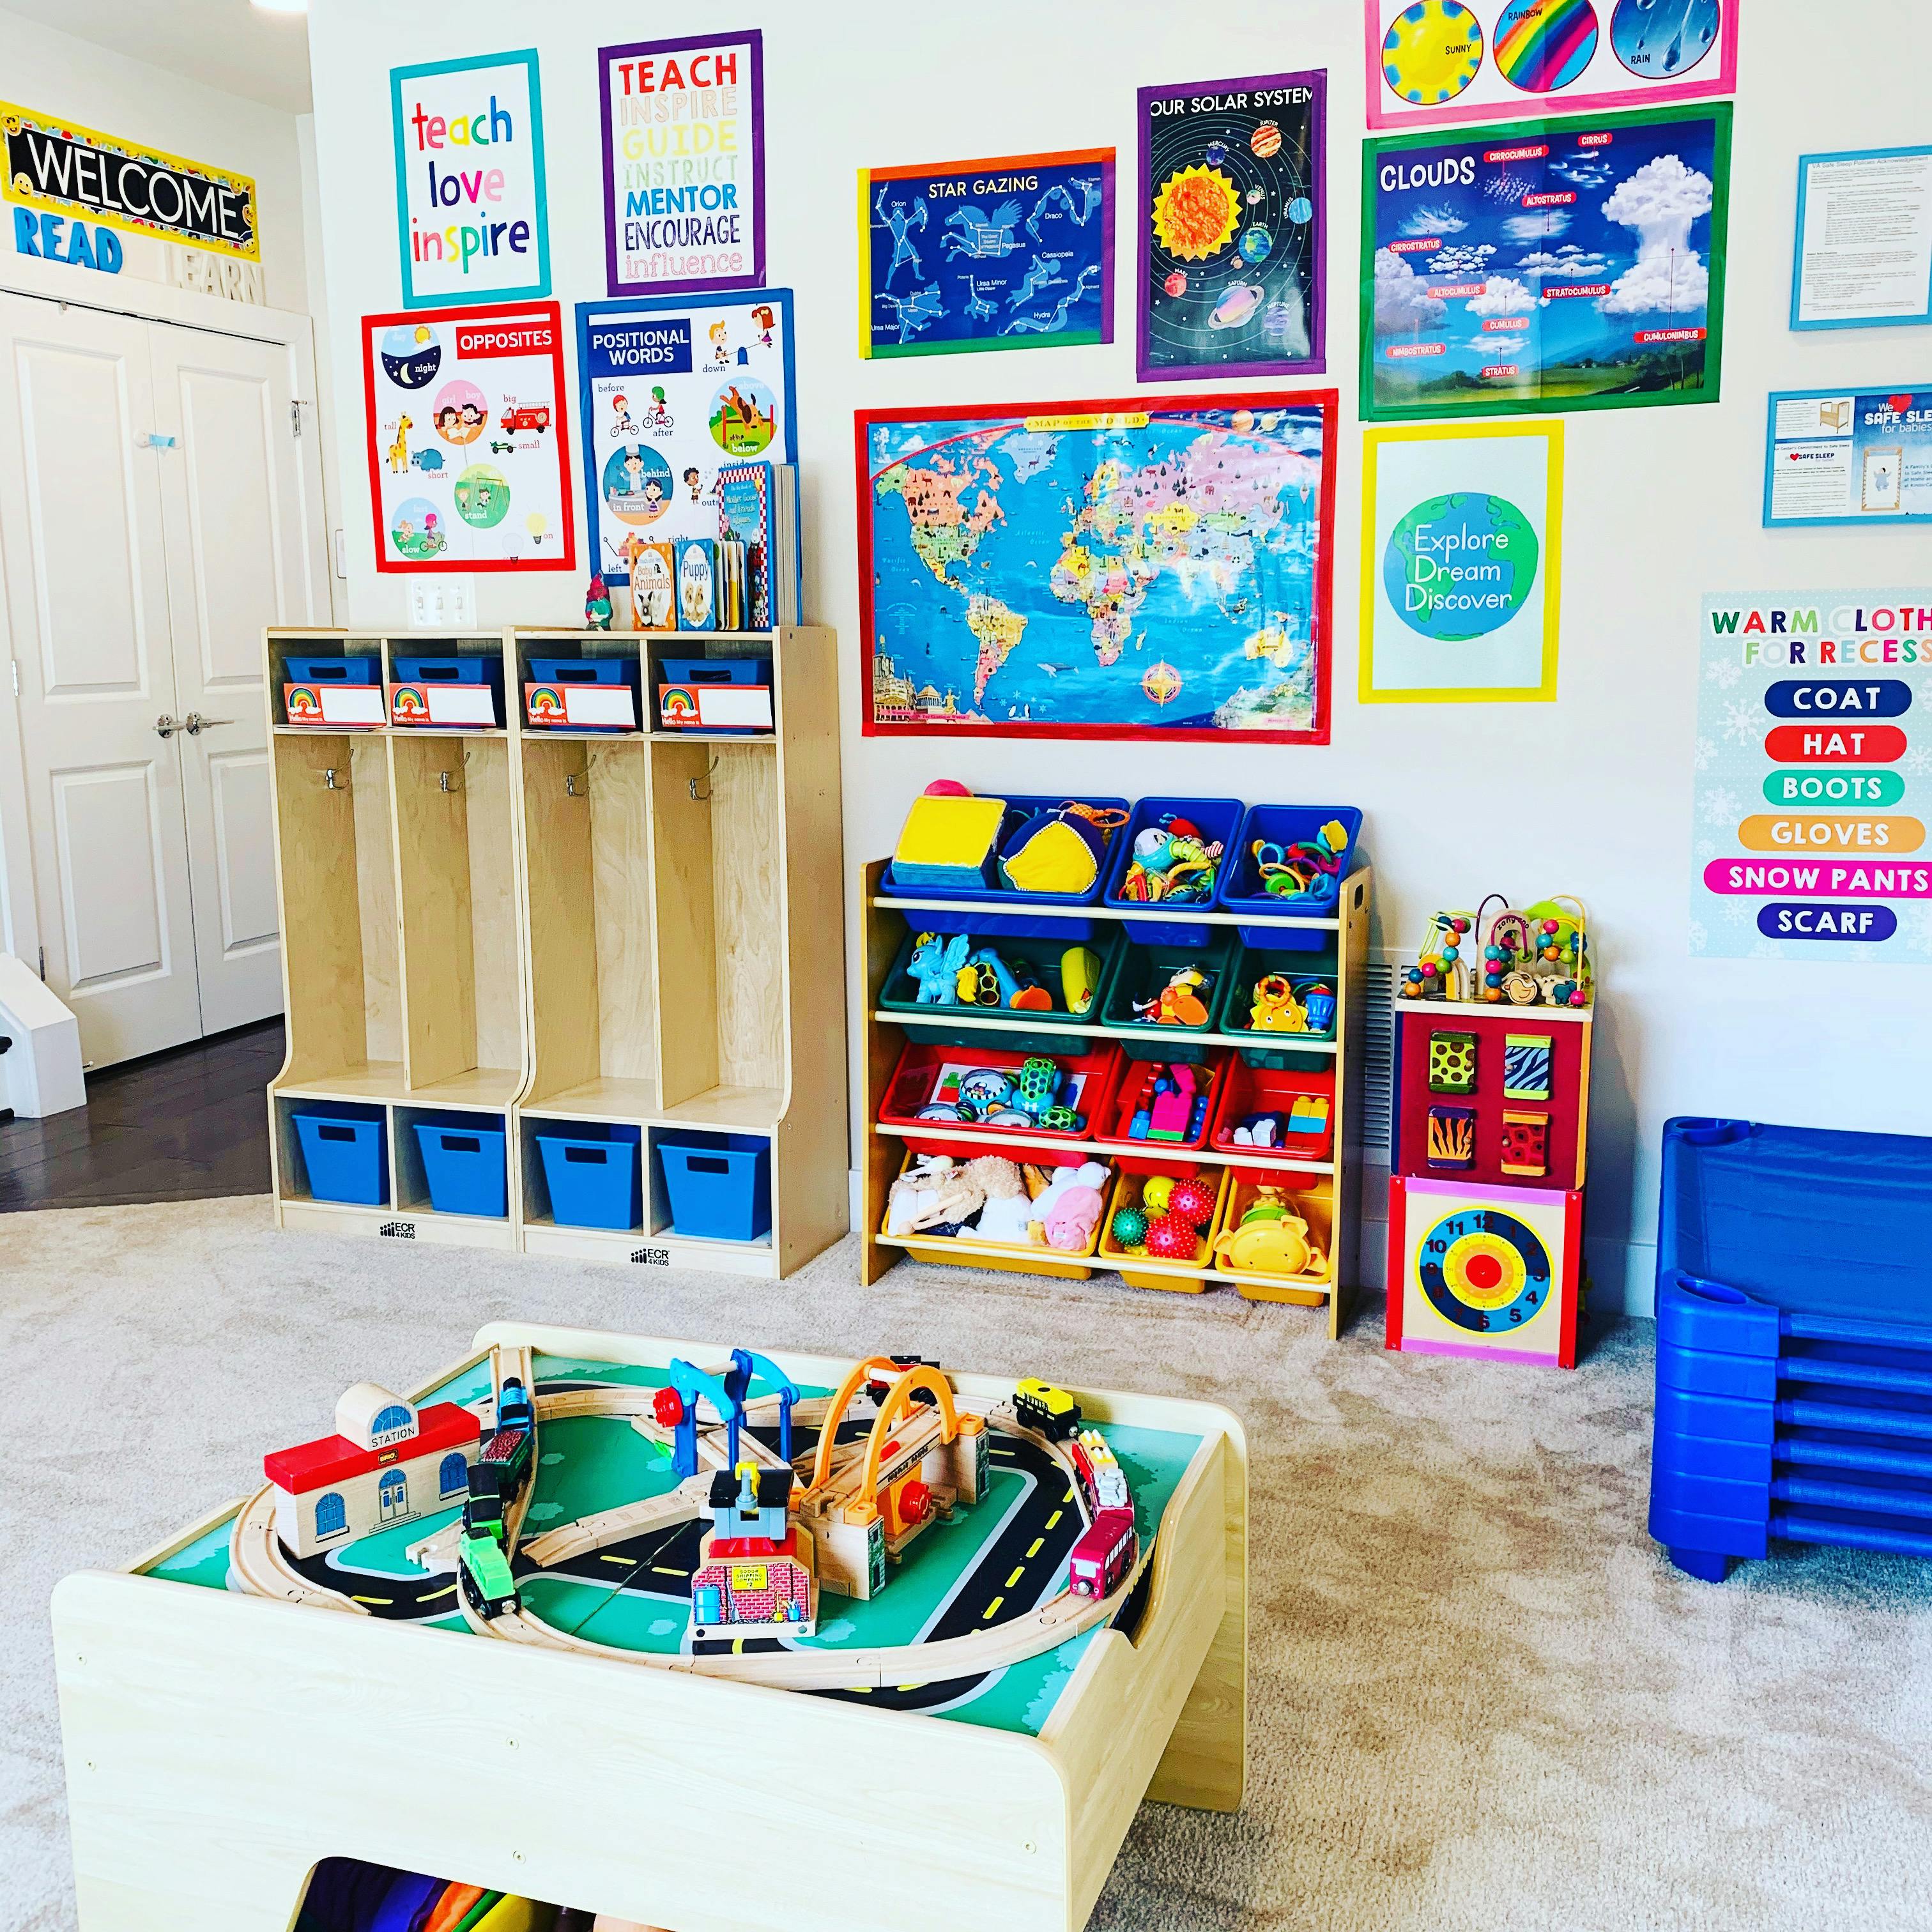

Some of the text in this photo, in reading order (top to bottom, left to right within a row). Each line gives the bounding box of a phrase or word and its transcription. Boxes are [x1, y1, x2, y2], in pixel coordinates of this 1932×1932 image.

[1508, 8, 1542, 20] RAINBOW
[1445, 43, 1471, 56] SUNNY
[1630, 54, 1650, 65] RAIN
[618, 53, 737, 95] TEACH
[620, 86, 737, 126] INSPIRE
[1150, 100, 1184, 116] OUR
[1190, 94, 1247, 112] SOLAR
[412, 96, 512, 151] teach
[622, 120, 737, 160] GUIDE
[1581, 134, 1608, 145] CIRRUS
[1208, 141, 1229, 153] MERCURY
[1489, 146, 1543, 161] CIRROCUMULUS
[624, 155, 738, 190] INSTRUCT
[1380, 156, 1475, 192] CLOUDS
[27, 133, 241, 240] WELCOME
[429, 160, 505, 207] love
[928, 175, 1038, 199] STAR GAZING
[1255, 184, 1265, 200] VENUS
[627, 184, 737, 217] MENTOR
[1526, 193, 1572, 206] ALTOSTRATUS
[1284, 196, 1293, 218] URANUS
[625, 215, 740, 251] ENCOURAGE
[13, 206, 123, 275] READ
[412, 211, 530, 273] inspire
[1390, 240, 1441, 252] CIRROSTRATUS
[625, 252, 743, 279] influence
[163, 243, 265, 308] LEARN
[1174, 268, 1188, 279] MARS
[1434, 286, 1480, 296] ALTOCUMULUS
[1546, 285, 1606, 297] STRATOCUMULUS
[1489, 319, 1522, 328] CUMULUS
[460, 330, 552, 351] OPPOSITES
[593, 329, 689, 349] POSITIONAL
[1643, 329, 1699, 341] CUMULONIMBUS
[609, 347, 674, 365] WORDS
[1392, 344, 1441, 355] NIMBOSTRATUS
[415, 363, 436, 374] night
[702, 364, 725, 372] down
[1485, 365, 1515, 377] STRATUS
[465, 390, 481, 401] boy
[598, 384, 625, 393] before
[441, 394, 456, 406] girl
[503, 394, 516, 404] big
[1878, 403, 1894, 412] We
[1864, 411, 1901, 425] SAFE
[384, 422, 397, 430] tall
[1882, 422, 1932, 434] for babies
[518, 440, 540, 450] small
[732, 443, 758, 452] below
[427, 471, 448, 479] short
[641, 467, 670, 478] behind
[464, 510, 487, 519] stand
[612, 503, 645, 512] in front
[402, 544, 420, 553] slow
[1415, 522, 1508, 564] Explore
[638, 566, 652, 578] Baby
[683, 560, 709, 581] Puppy
[1415, 555, 1501, 583] Dream
[634, 574, 670, 590] Animals
[1406, 584, 1512, 611] Discover
[1712, 610, 1818, 634] WARM
[1745, 640, 1932, 665] FOR RECESS
[1793, 688, 1881, 710] COAT
[662, 717, 676, 725] Hello
[1803, 733, 1866, 755] HAT
[1783, 778, 1882, 799] BOOTS
[1771, 822, 1890, 846] GLOVES
[1728, 866, 1929, 892] SNOW PANTS
[1498, 918, 1515, 930] zany
[1778, 910, 1874, 934] SCARF
[395, 1223, 415, 1232] ECR
[1446, 1221, 1464, 1236] 11
[1473, 1214, 1494, 1229] 12
[1426, 1239, 1446, 1254] 10
[1526, 1243, 1538, 1256] 2
[648, 1249, 668, 1259] ECR
[1425, 1262, 1438, 1275] 9
[1533, 1268, 1545, 1282] 3
[1526, 1291, 1538, 1305] 4
[1478, 1314, 1490, 1330] 6
[1509, 1308, 1522, 1322] 5
[372, 1427, 414, 1447] STATION
